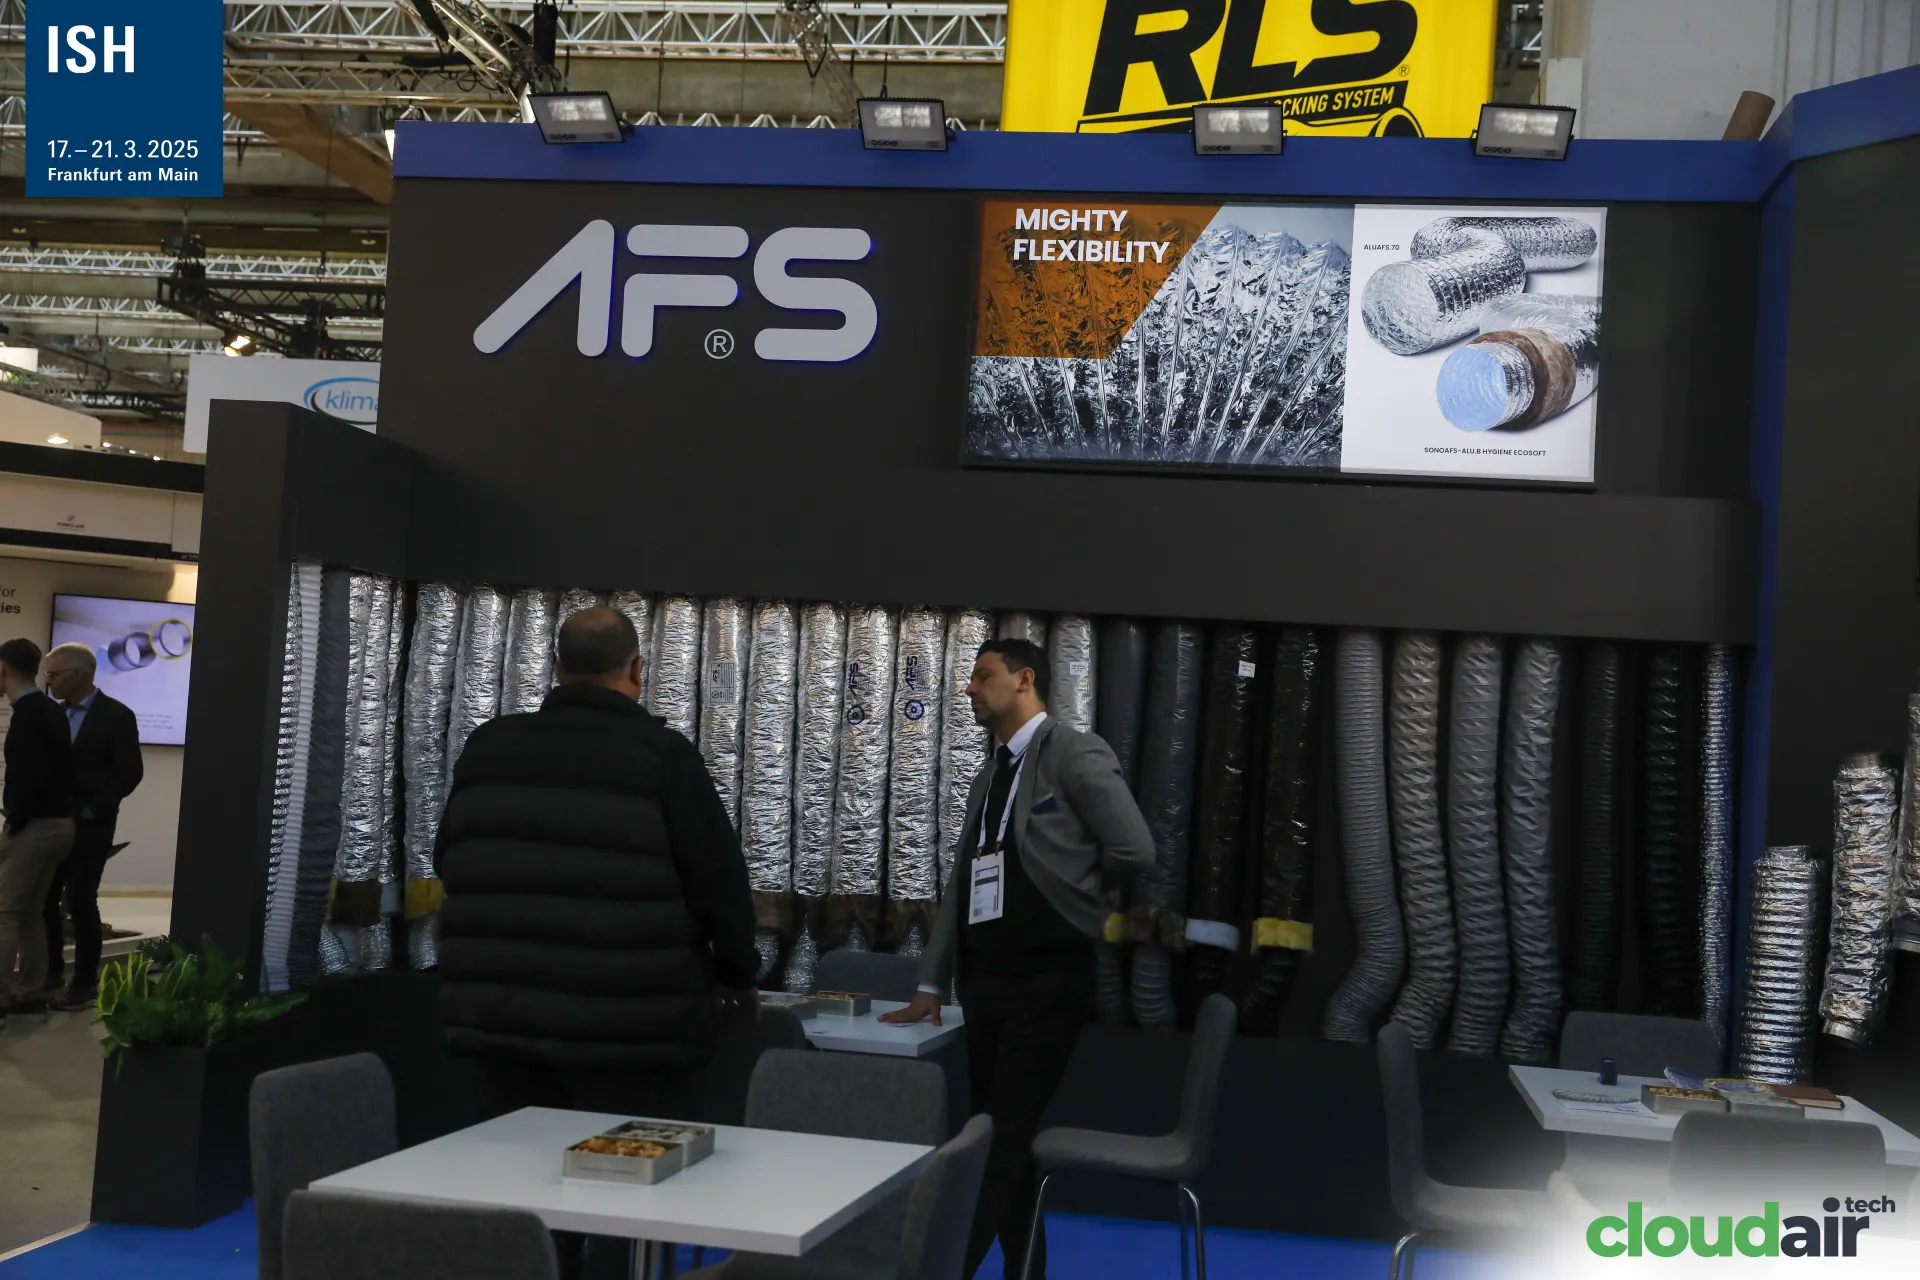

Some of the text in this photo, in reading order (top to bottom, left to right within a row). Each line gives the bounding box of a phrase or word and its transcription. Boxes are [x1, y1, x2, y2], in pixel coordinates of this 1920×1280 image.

[1083, 0, 1418, 116] RLS
[1332, 86, 1395, 110] SYSTEM
[1015, 208, 1128, 231] MIGHTY
[1013, 238, 1171, 263] FLEXIBILITY
[472, 219, 878, 362] AFS
[1482, 448, 1512, 456] HYGIENE
[1513, 449, 1547, 457] ECOSOFT
